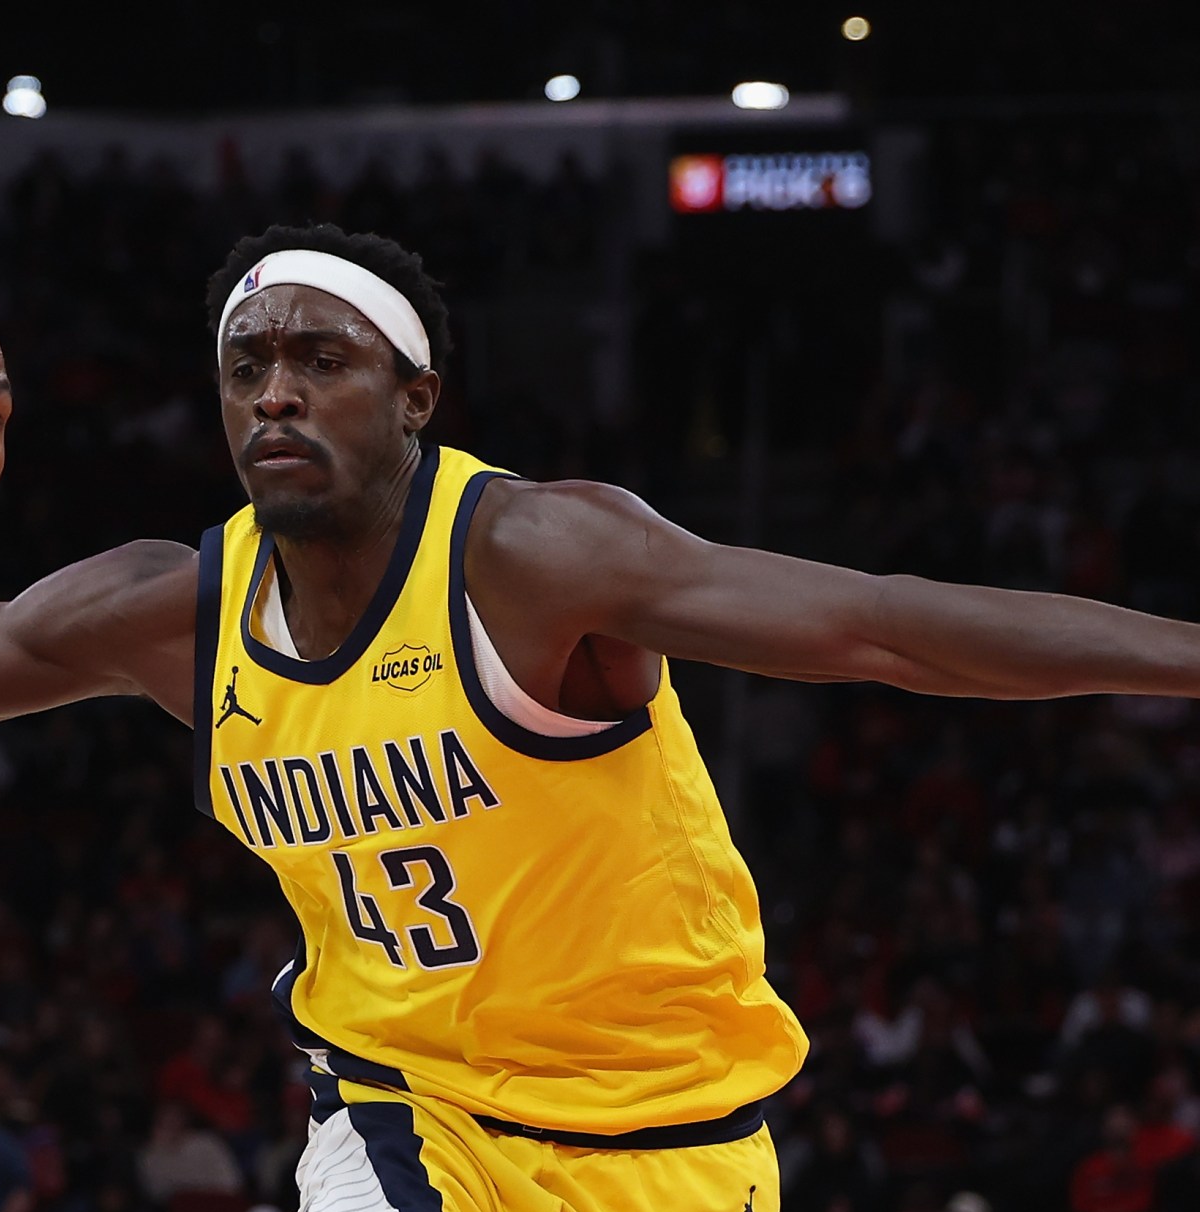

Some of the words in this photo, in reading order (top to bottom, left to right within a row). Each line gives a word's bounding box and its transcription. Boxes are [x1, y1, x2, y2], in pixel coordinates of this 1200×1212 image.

[372, 657, 420, 682] LUCAS
[423, 652, 443, 672] OIL
[220, 728, 501, 848] INDIANA
[329, 845, 482, 971] 43
